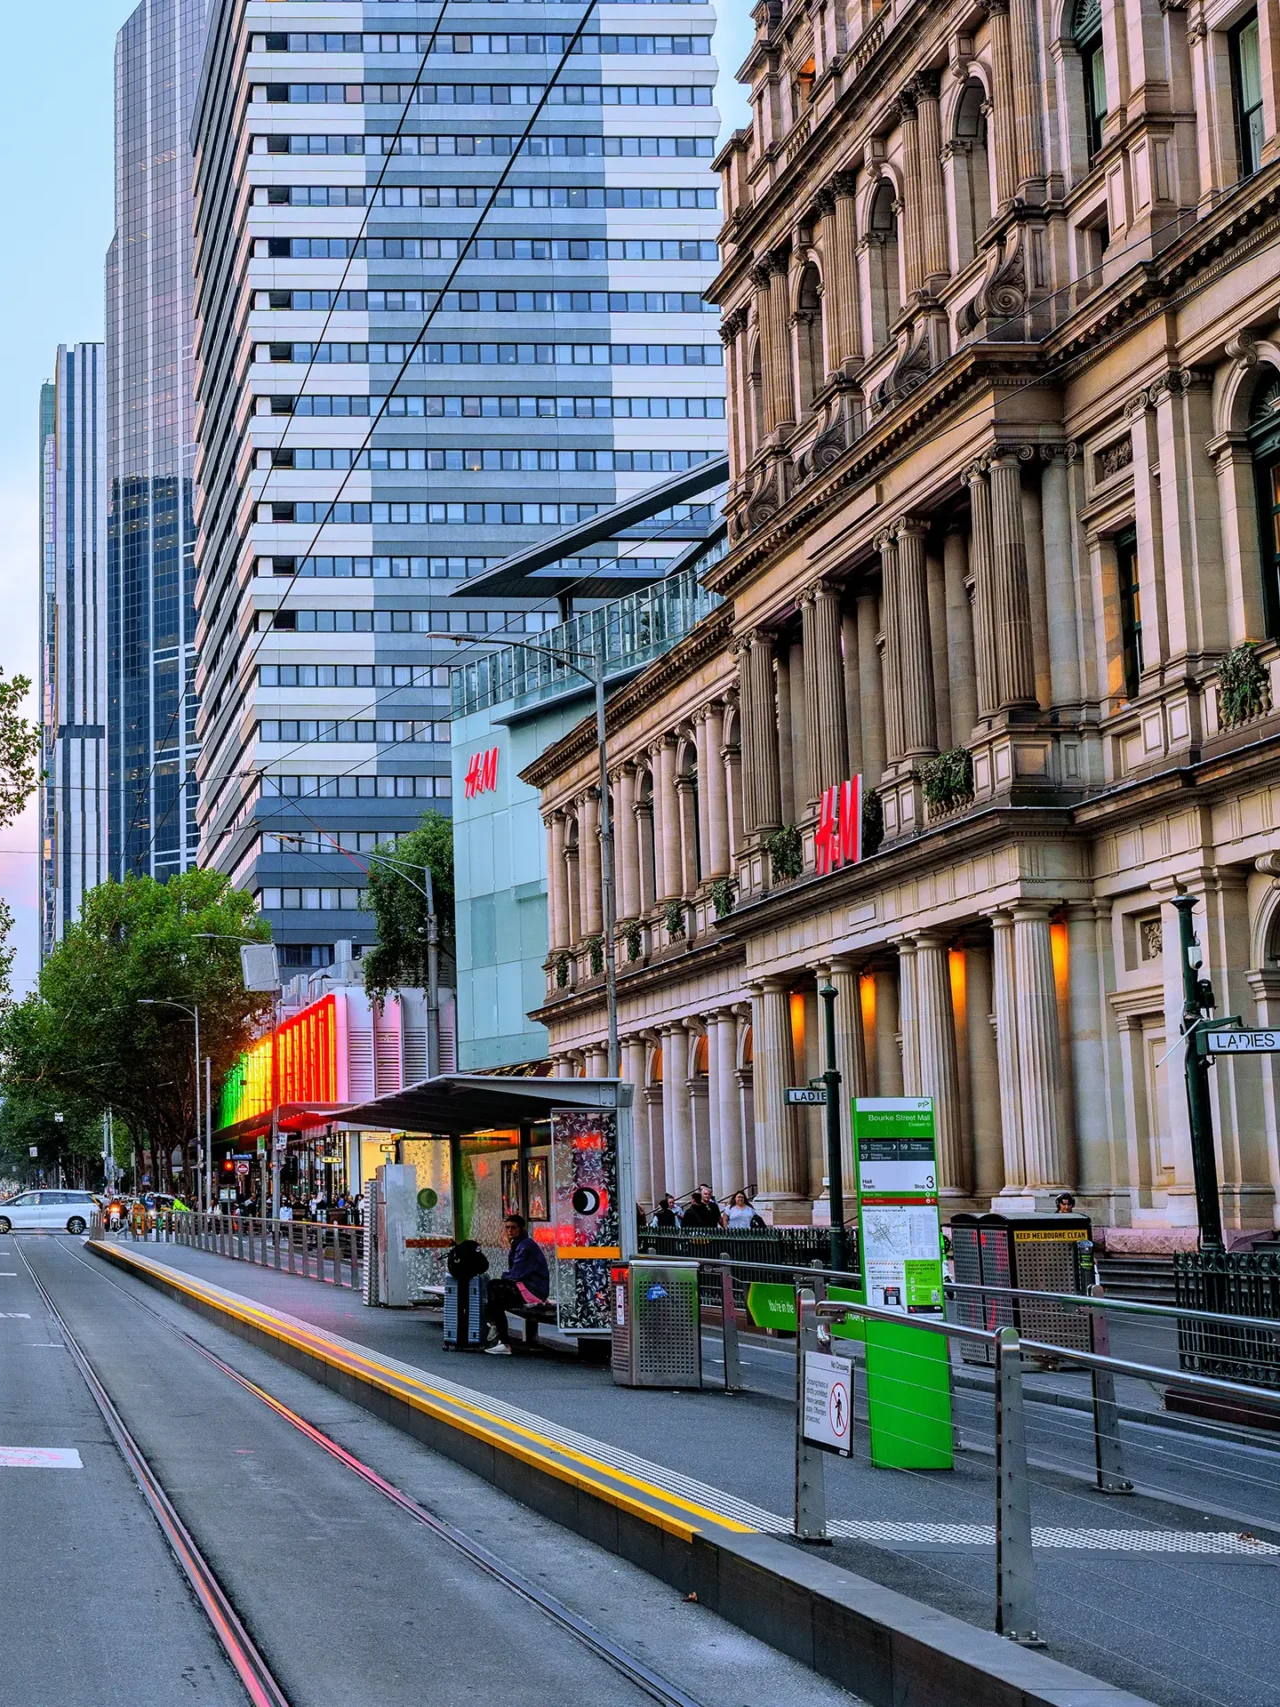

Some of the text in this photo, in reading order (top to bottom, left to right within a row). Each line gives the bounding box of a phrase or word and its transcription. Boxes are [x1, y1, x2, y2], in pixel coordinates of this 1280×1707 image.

[464, 746, 499, 798] H&M
[814, 773, 862, 876] H&M
[1217, 1033, 1276, 1049] LADIES
[794, 1091, 827, 1101] LADIE
[926, 1175, 935, 1189] 3
[1015, 1232, 1031, 1240] KEEP
[1067, 1231, 1086, 1239] CLEAN
[768, 1299, 795, 1313] You're in the
[831, 1360, 849, 1373] No Crossing
